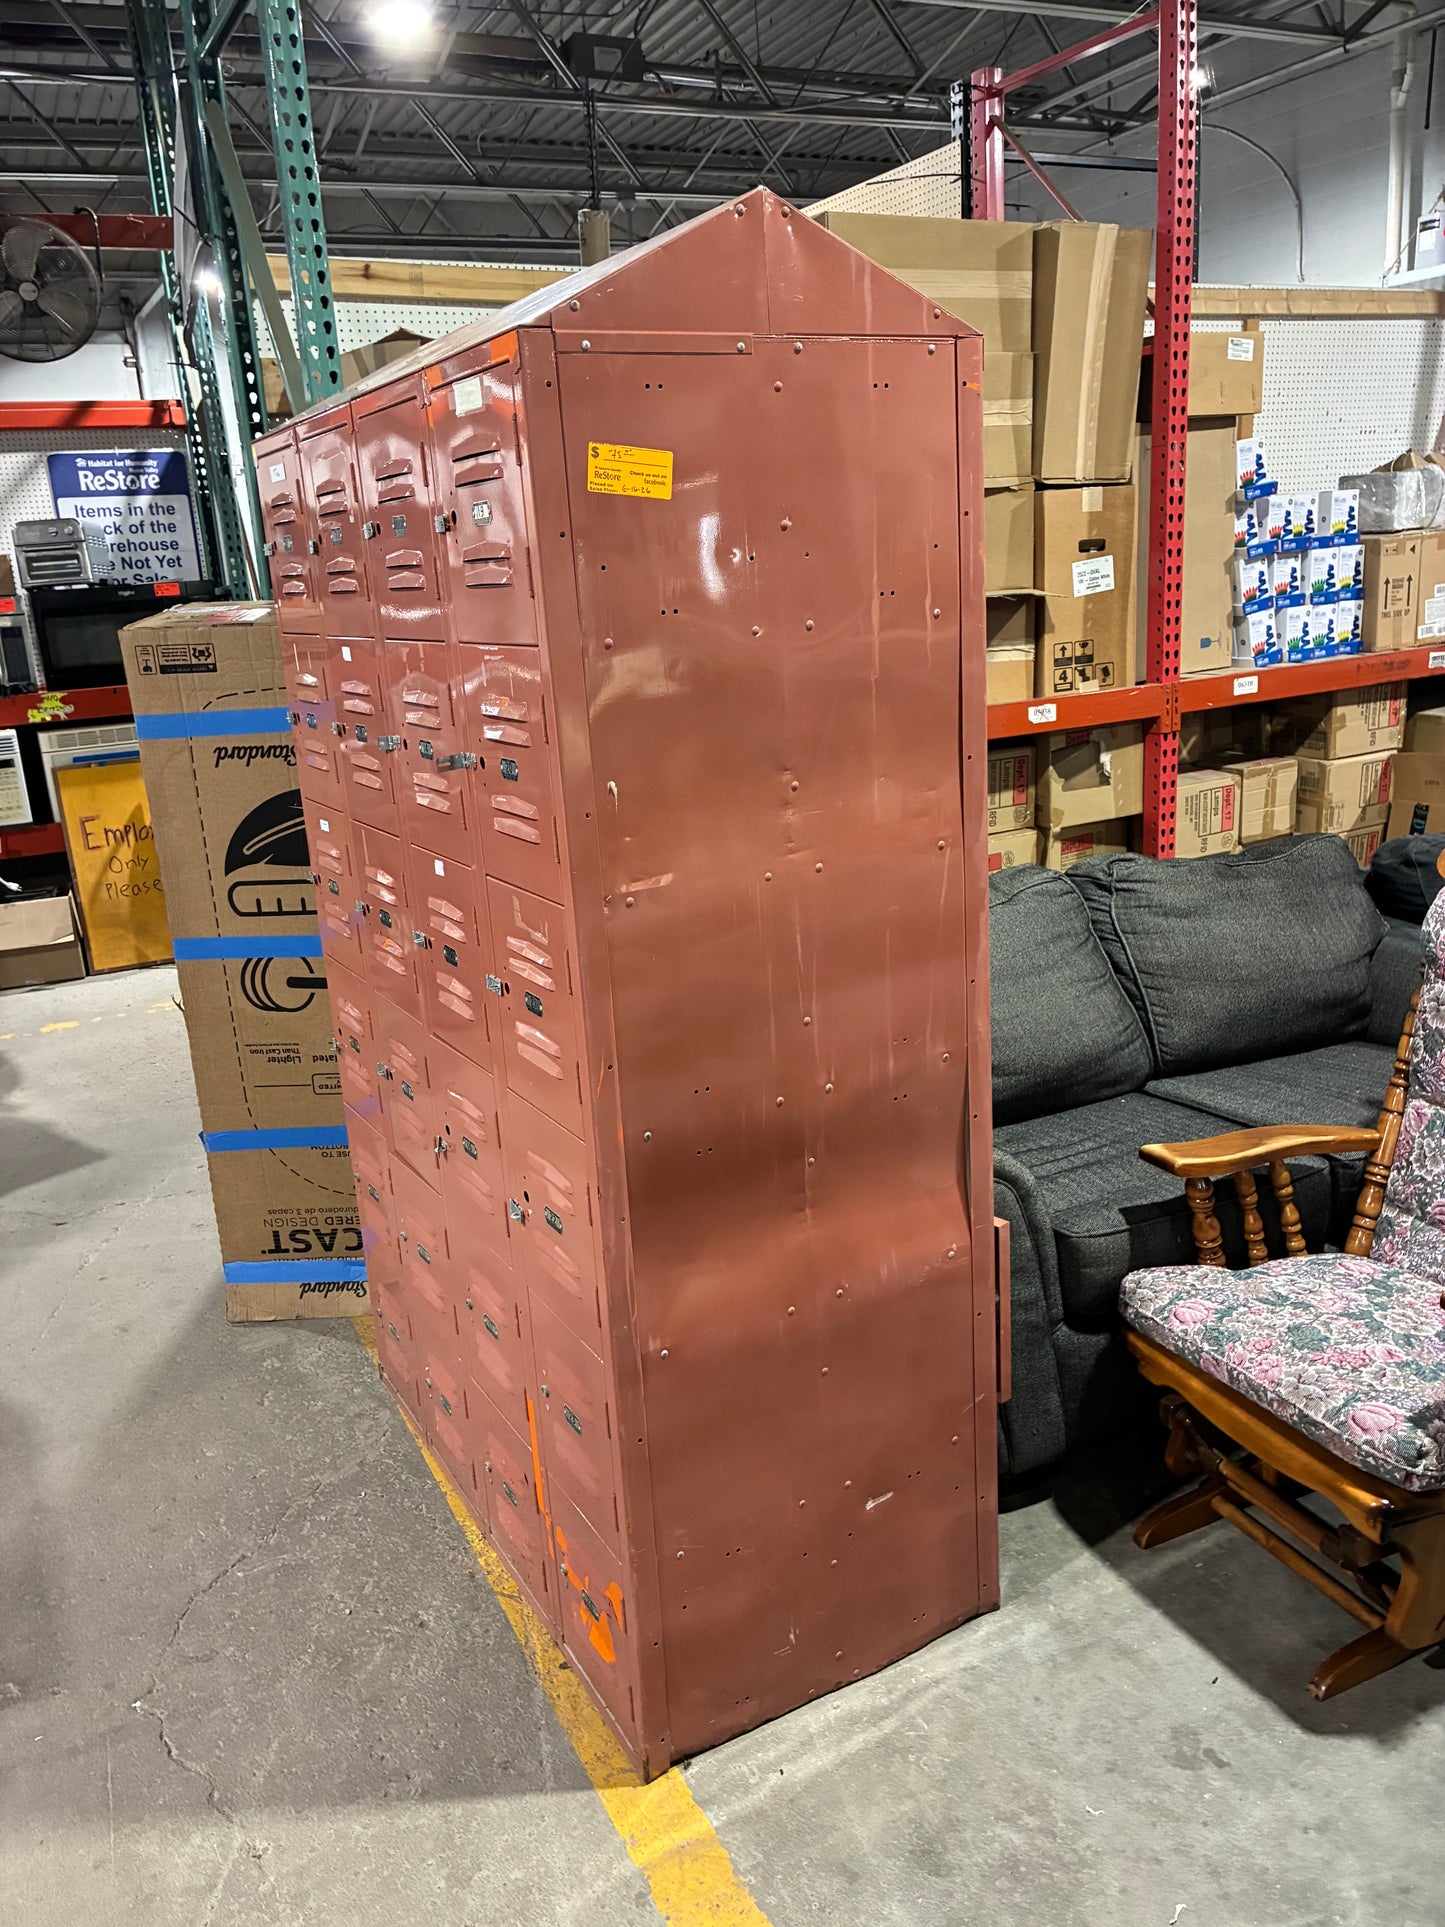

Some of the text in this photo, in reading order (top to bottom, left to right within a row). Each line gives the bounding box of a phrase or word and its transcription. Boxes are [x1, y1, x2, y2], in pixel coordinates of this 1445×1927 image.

[591, 446, 600, 460] $
[88, 459, 158, 468] Habitat for Humanity
[78, 470, 160, 491] ReStore
[594, 470, 621, 481] ReStore
[74, 502, 176, 518] Items in the
[104, 519, 177, 535] ck of the
[108, 539, 179, 553] rehouse
[121, 556, 151, 570] Not
[155, 554, 183, 568] Yet
[214, 744, 297, 768] Standard
[1003, 761, 1012, 788] Lamps
[1016, 758, 1025, 794] Dept. 17
[1224, 788, 1232, 820] Dept. 17
[989, 811, 997, 827] RFID
[109, 854, 150, 873] Only
[105, 878, 163, 900] Please
[267, 1056, 301, 1064] Lighter
[312, 1055, 337, 1063] lated
[267, 1208, 294, 1216] capas
[304, 1208, 315, 1216] de
[319, 1207, 358, 1215] duradero
[263, 1216, 360, 1227] ERED DESIGN
[299, 1281, 368, 1300] Standard
